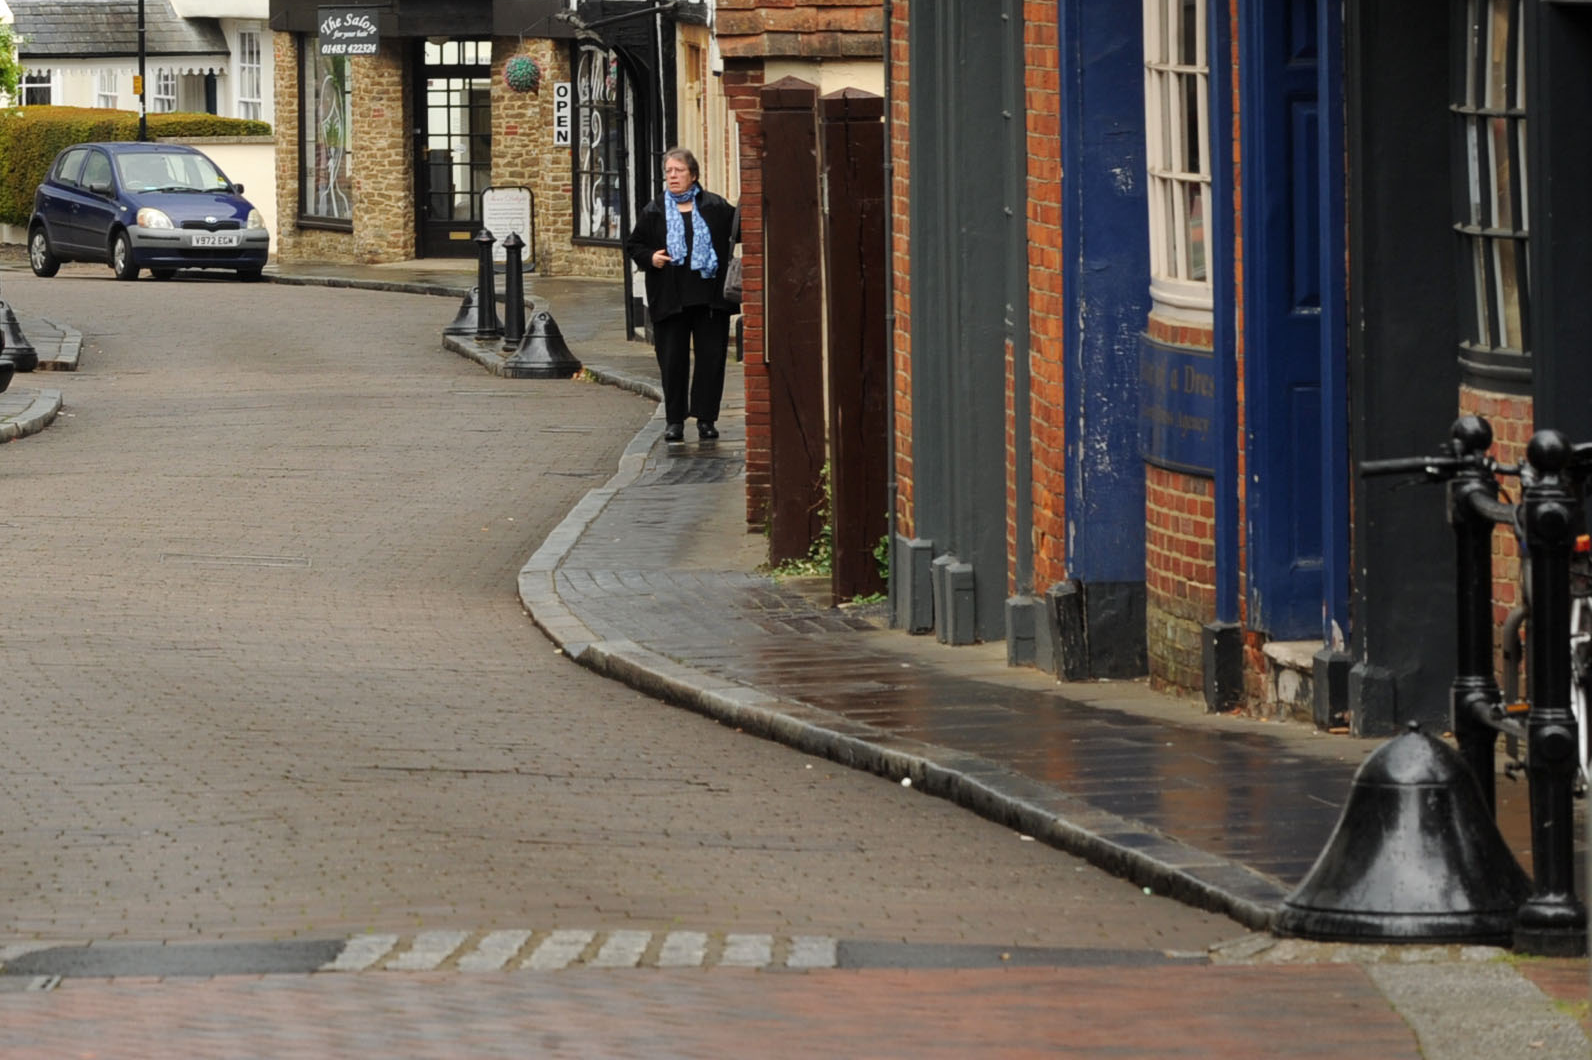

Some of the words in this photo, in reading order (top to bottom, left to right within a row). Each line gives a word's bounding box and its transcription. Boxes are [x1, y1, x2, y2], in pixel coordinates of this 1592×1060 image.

[320, 16, 342, 36] The
[343, 13, 378, 35] Salon
[321, 43, 347, 55] 01483
[557, 85, 569, 143] OPEN
[195, 236, 217, 245] V972
